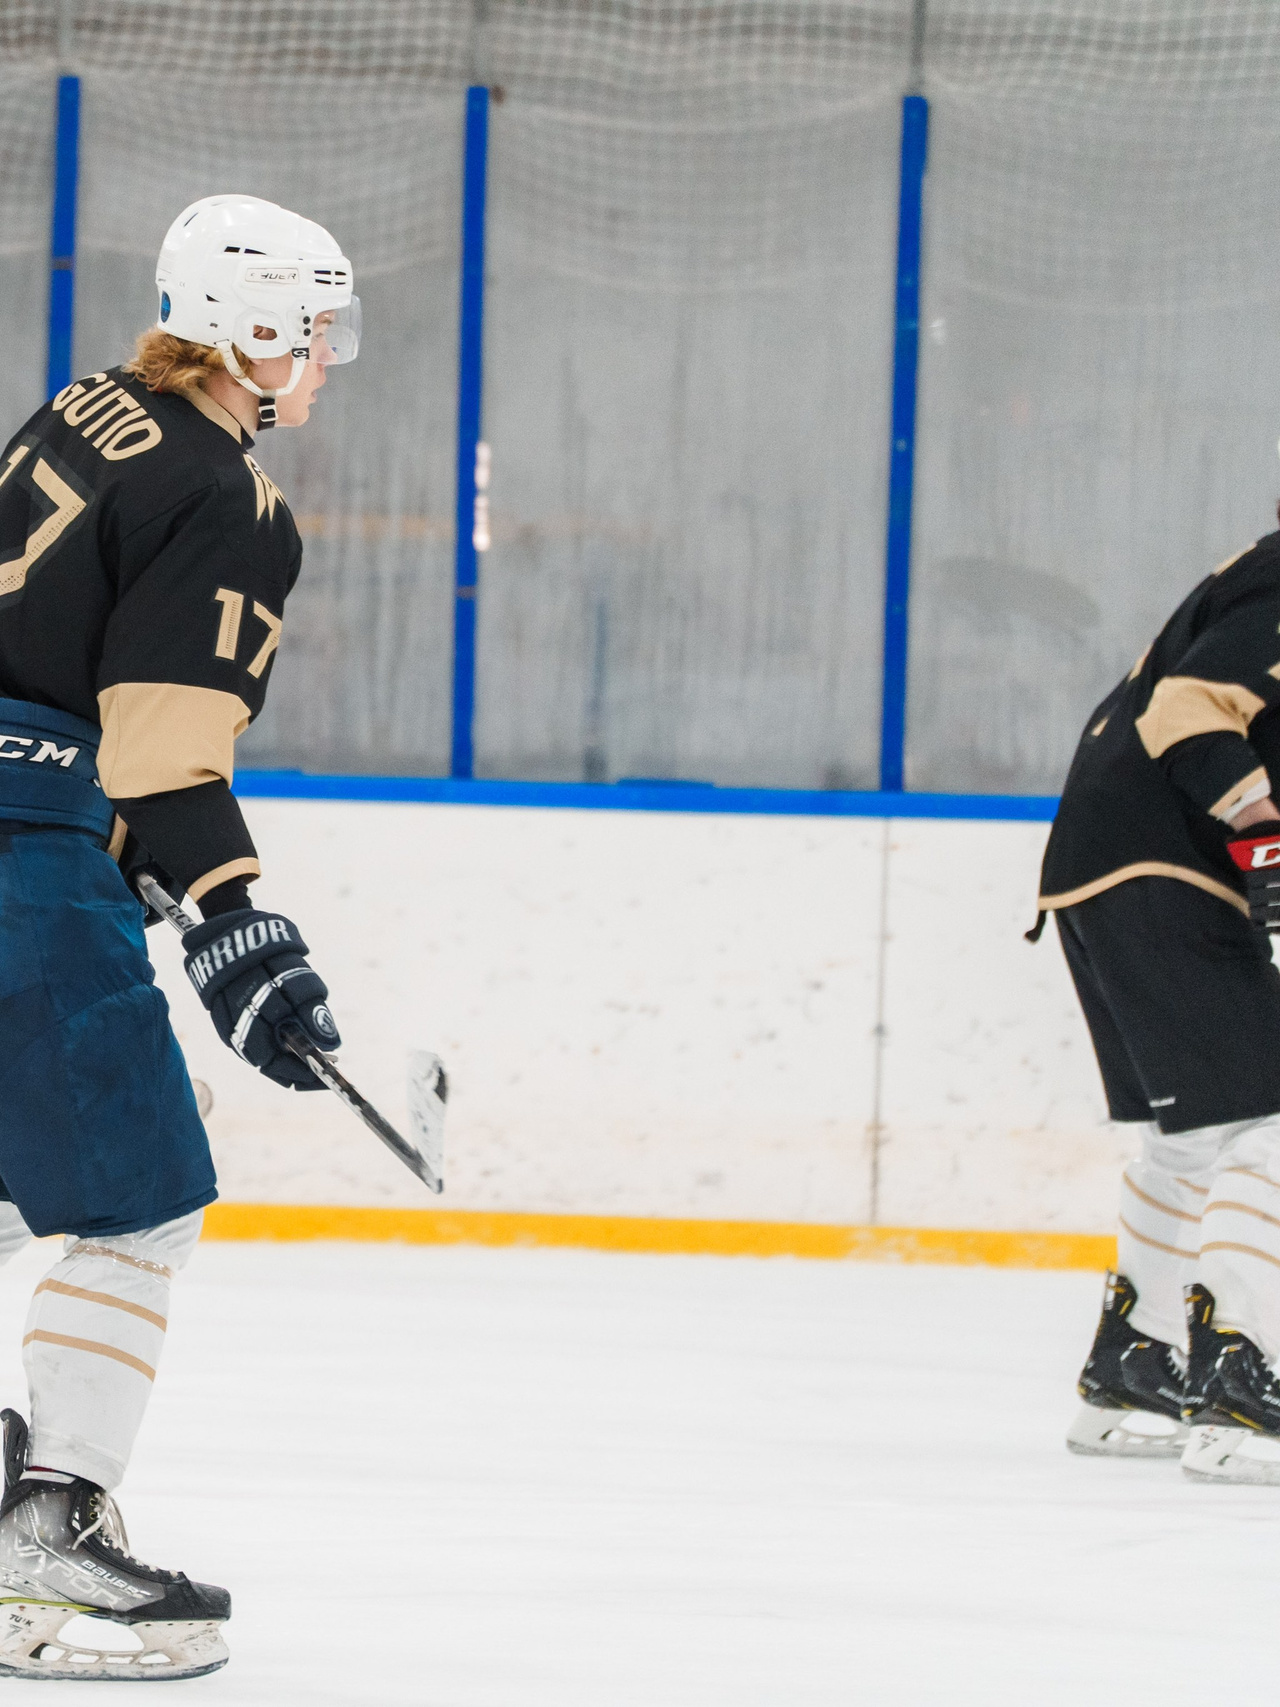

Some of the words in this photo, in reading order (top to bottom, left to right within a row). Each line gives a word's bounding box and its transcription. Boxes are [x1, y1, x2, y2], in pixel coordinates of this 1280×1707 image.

[250, 272, 298, 280] AUER
[214, 587, 283, 679] 17
[187, 919, 292, 993] ARRIOR
[9, 1613, 35, 1627] TUK
